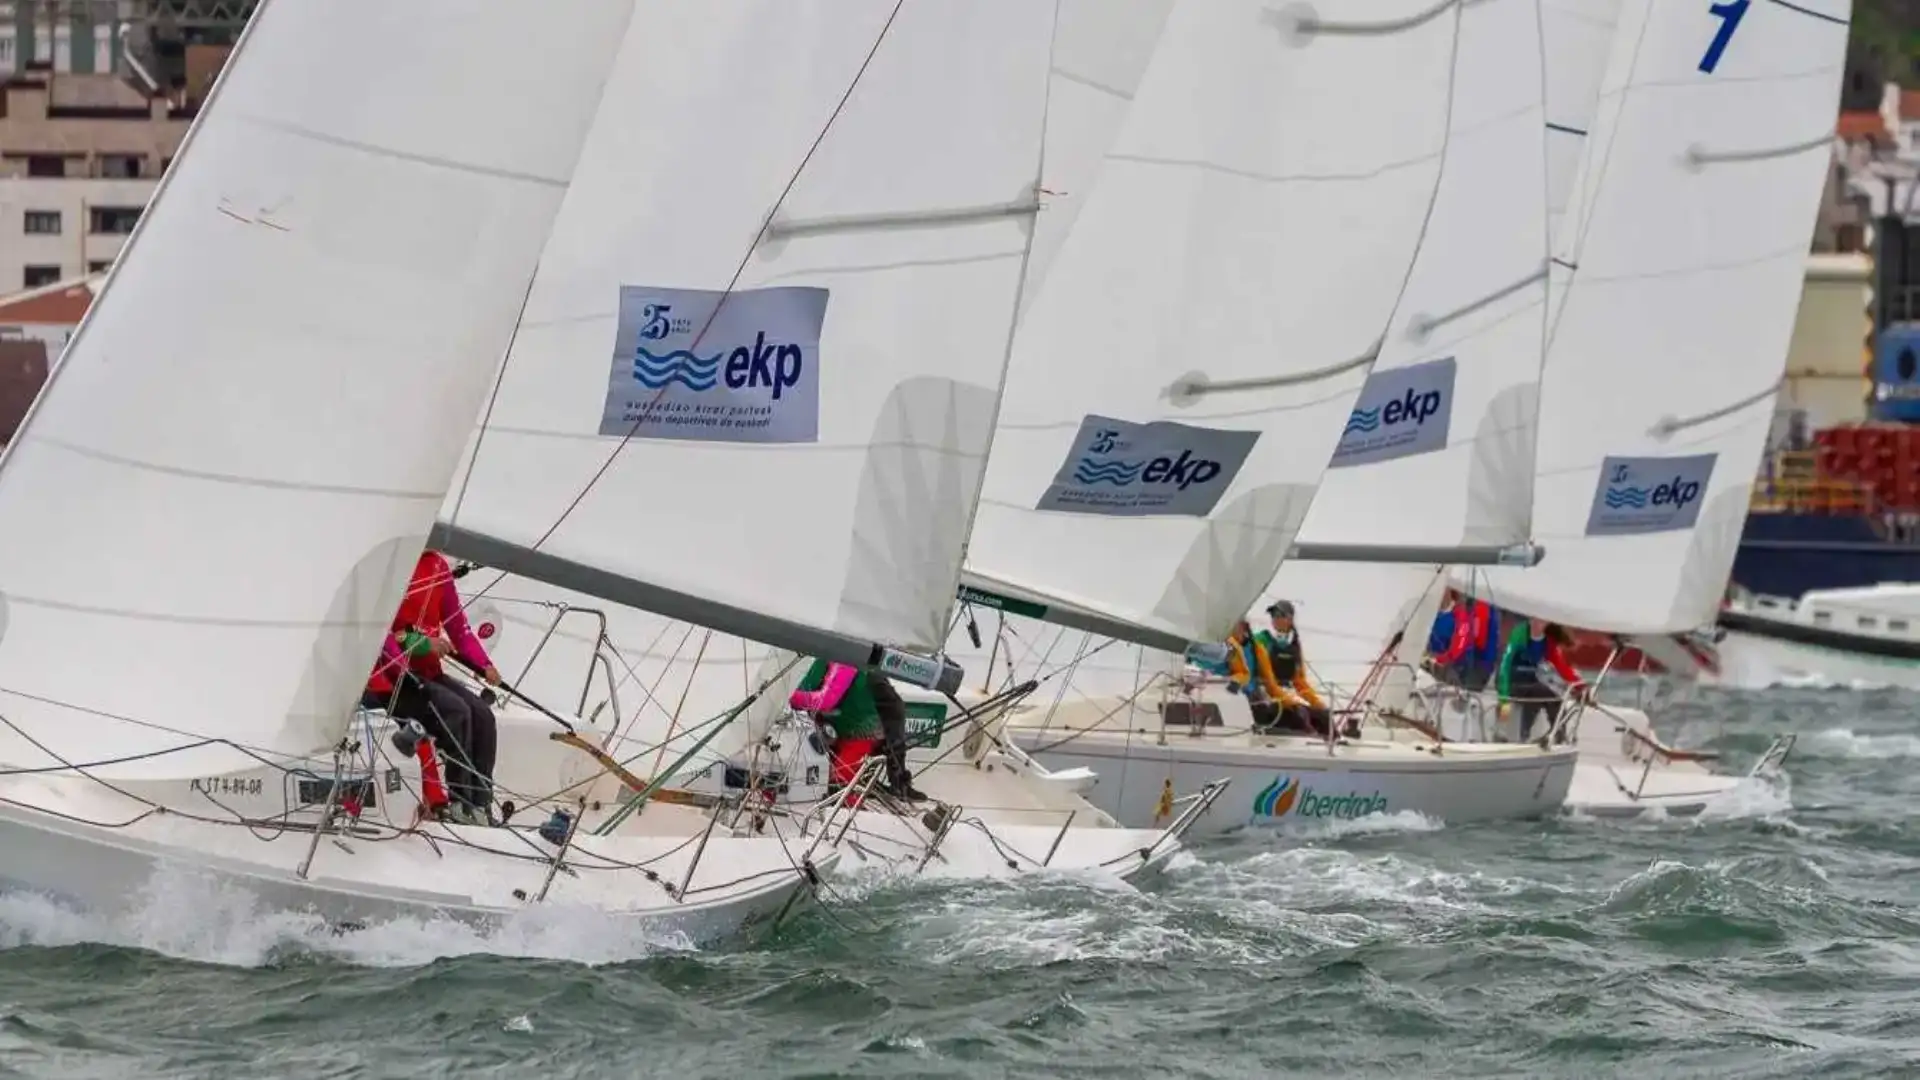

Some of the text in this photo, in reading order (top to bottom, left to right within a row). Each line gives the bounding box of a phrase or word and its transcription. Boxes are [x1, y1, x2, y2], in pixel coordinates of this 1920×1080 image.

[1697, 0, 1751, 74] 1
[640, 303, 671, 340] 25
[724, 331, 803, 400] ekp
[1383, 387, 1441, 426] ekp
[1141, 449, 1222, 491] ekp
[1652, 474, 1699, 510] ekp
[1296, 786, 1387, 820] Iberdrola
